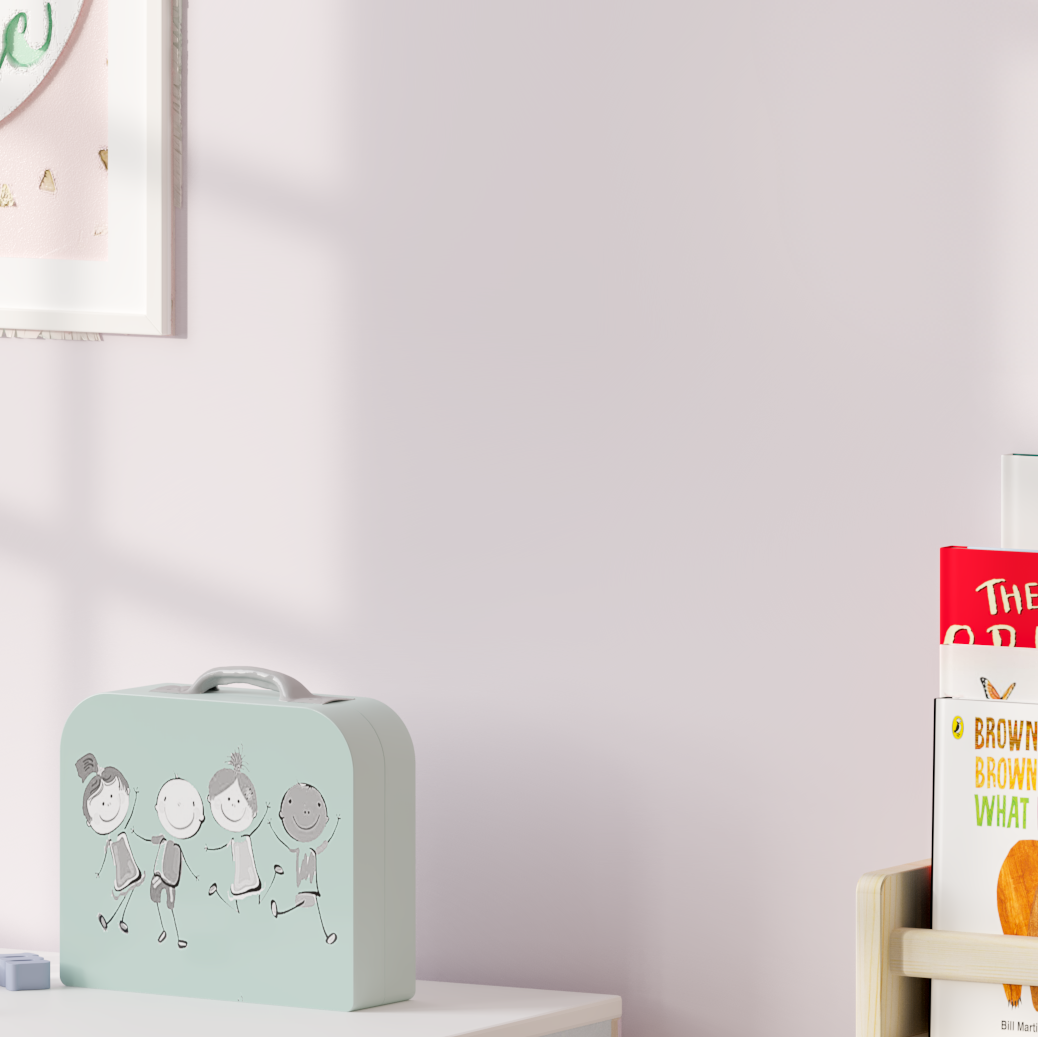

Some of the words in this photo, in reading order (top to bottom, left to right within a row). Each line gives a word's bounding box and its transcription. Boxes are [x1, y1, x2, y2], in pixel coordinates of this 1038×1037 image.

[974, 716, 1038, 752] BROWN
[975, 756, 1038, 791] BROWN
[974, 794, 1029, 830] WHAT
[1001, 1020, 1015, 1032] Bill
